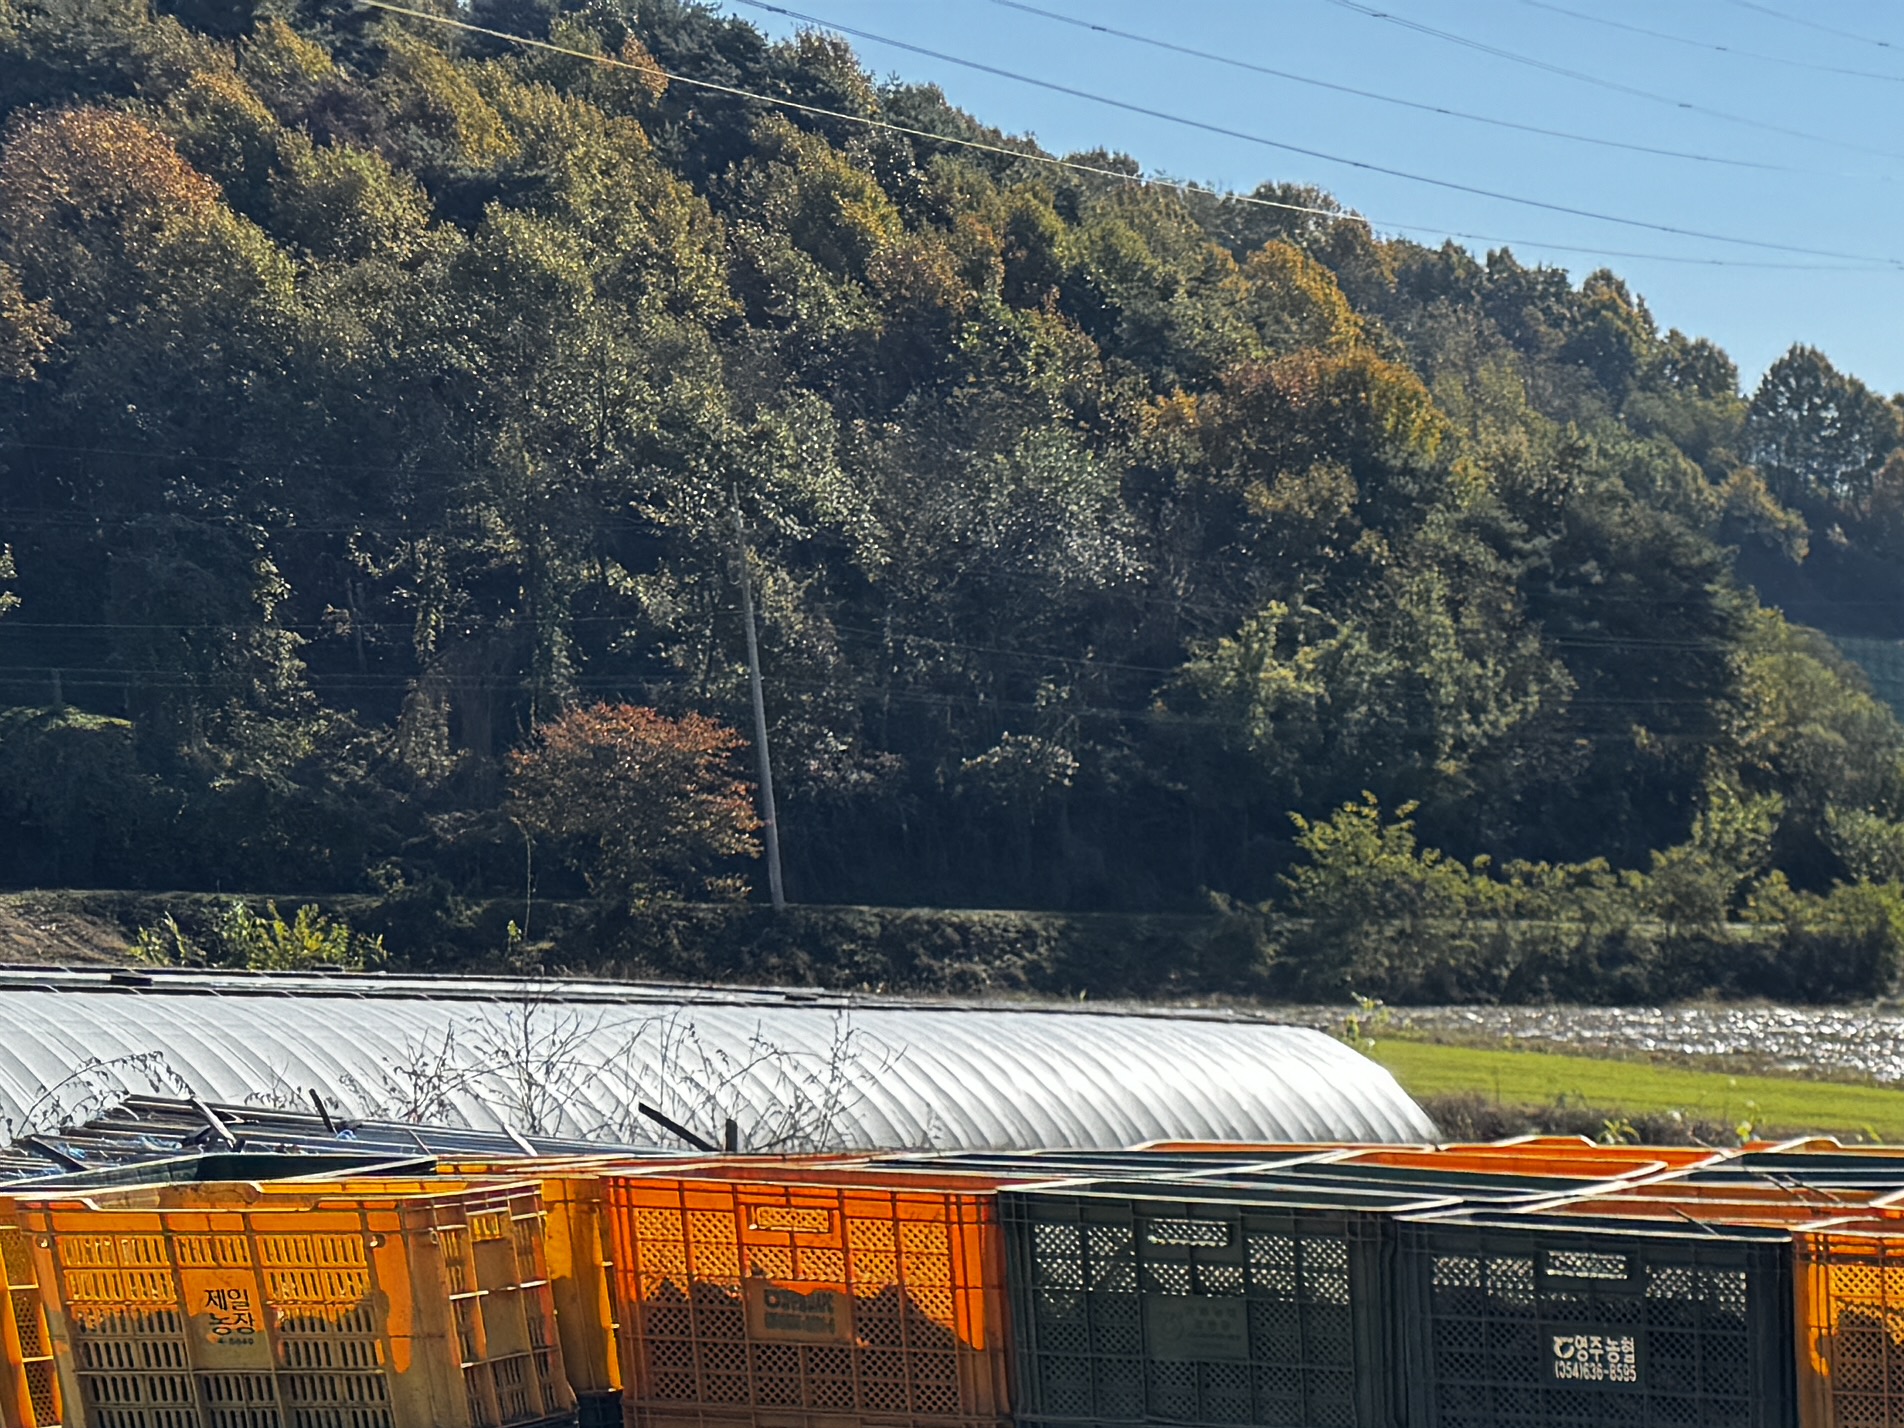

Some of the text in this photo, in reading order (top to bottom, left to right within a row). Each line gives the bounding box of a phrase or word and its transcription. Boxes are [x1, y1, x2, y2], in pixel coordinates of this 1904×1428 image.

[204, 1288, 250, 1311] 제일
[208, 1311, 255, 1336] 농장
[1574, 1334, 1636, 1364] 영주농협
